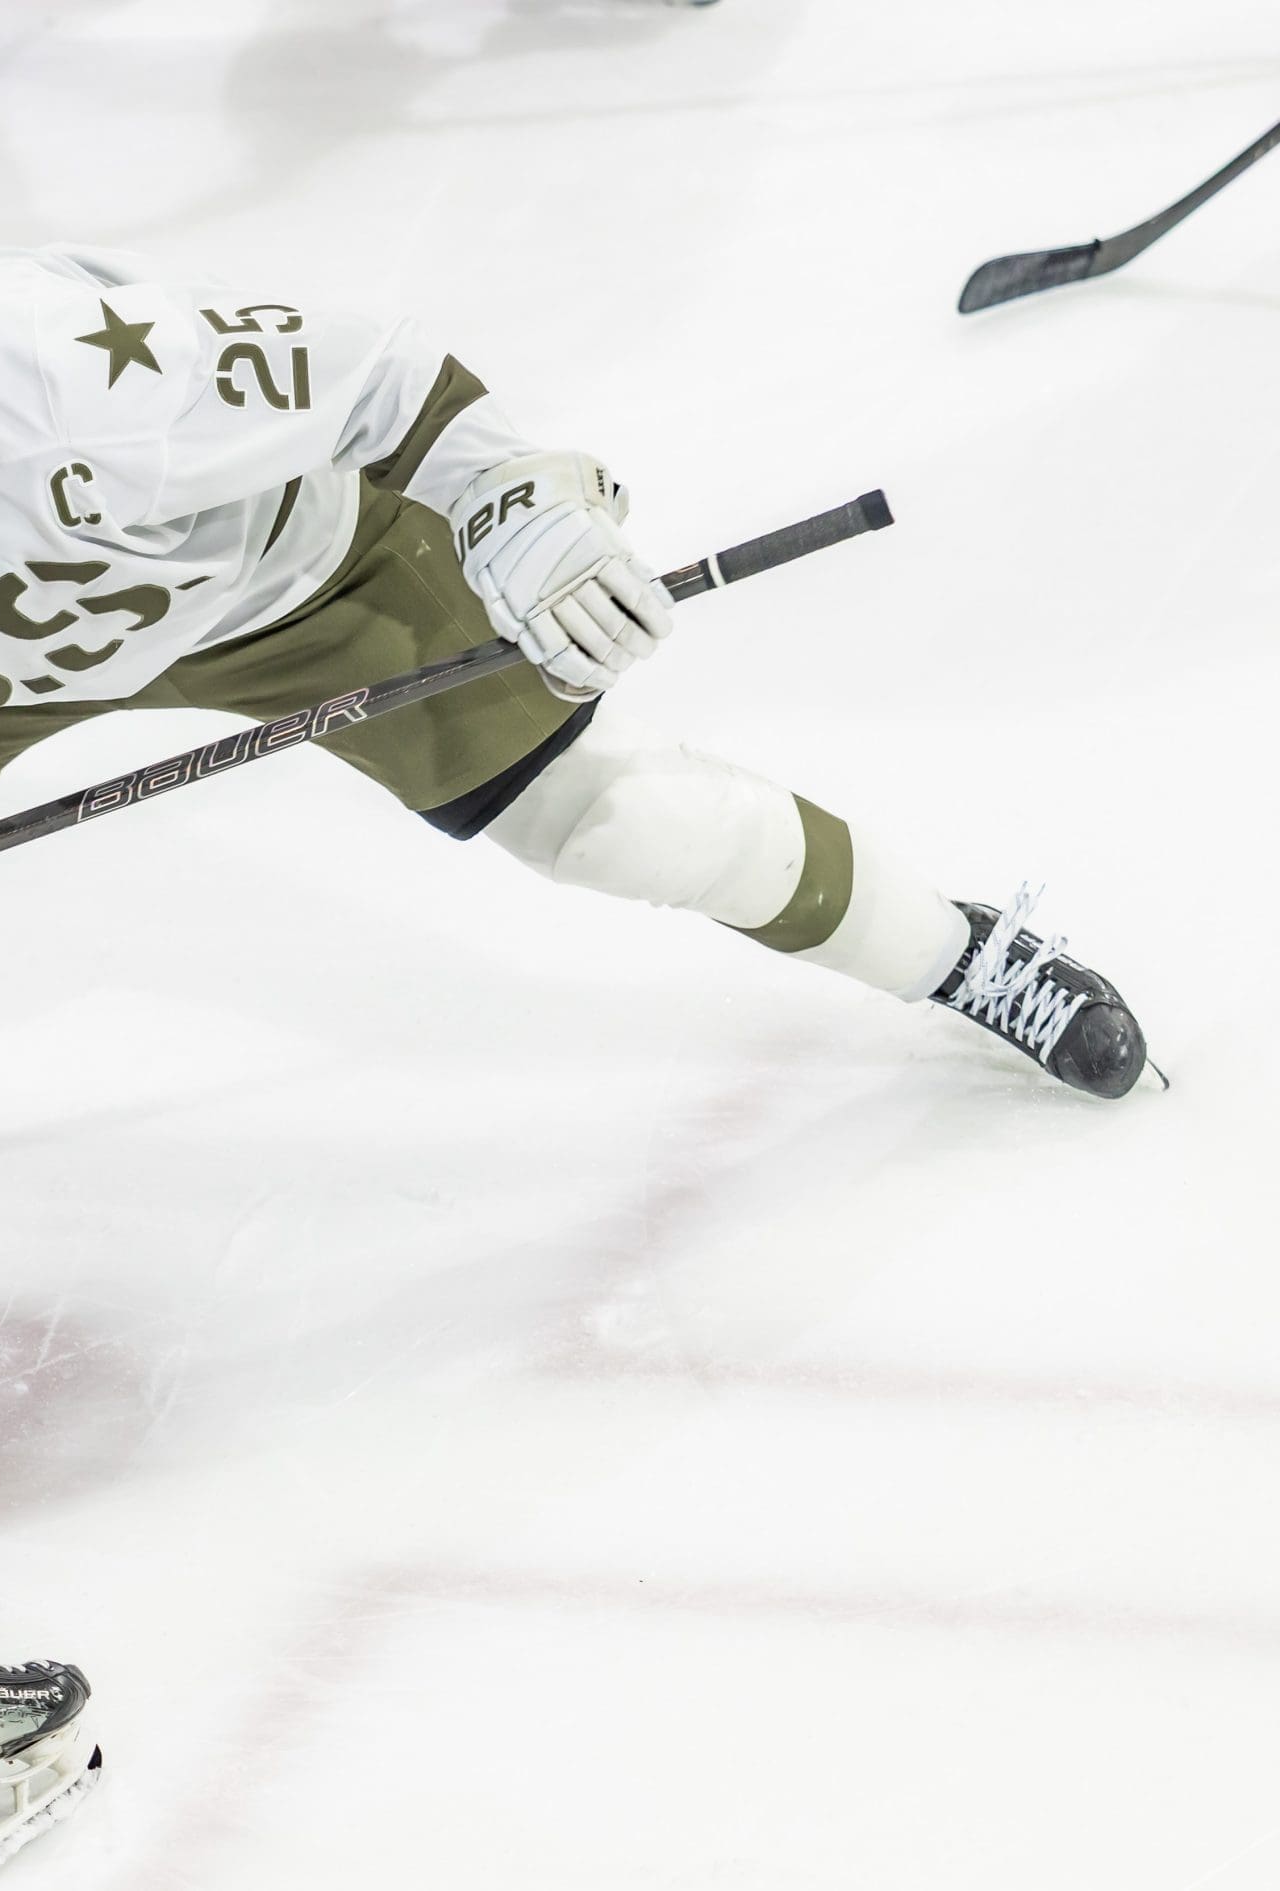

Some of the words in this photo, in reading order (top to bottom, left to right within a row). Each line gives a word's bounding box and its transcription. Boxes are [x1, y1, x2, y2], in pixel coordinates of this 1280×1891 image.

[199, 304, 312, 411] 25
[50, 462, 102, 528] C
[78, 687, 369, 823] BAUER
